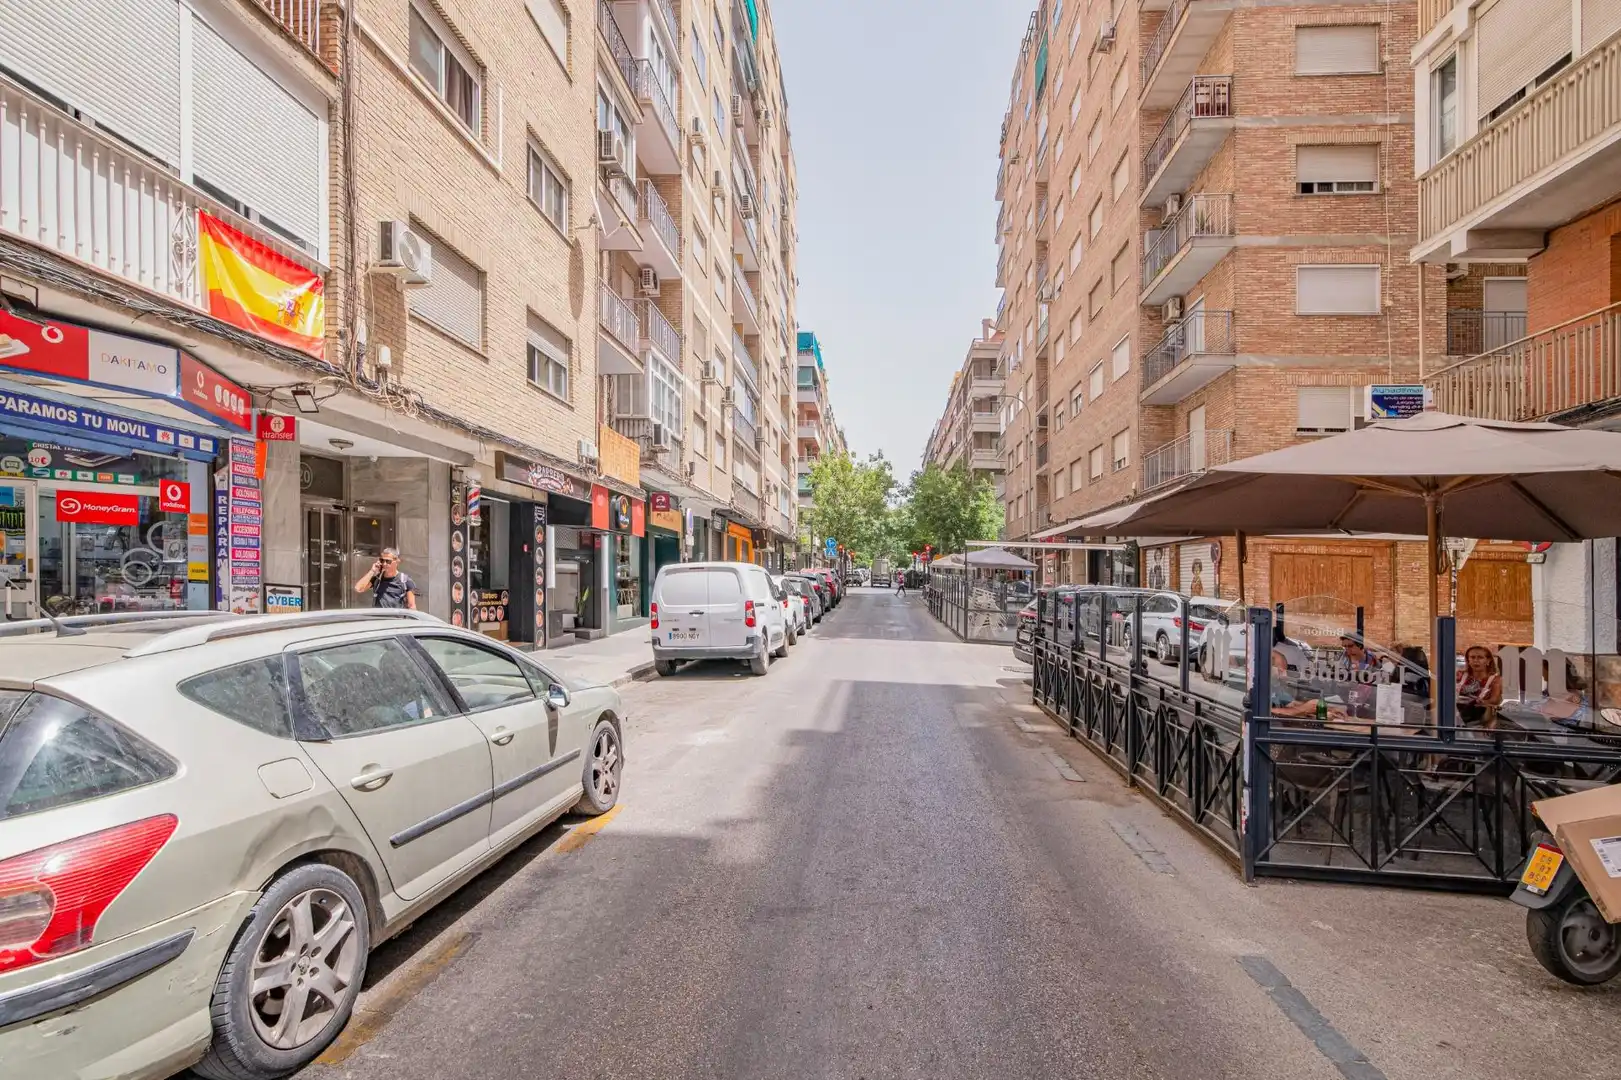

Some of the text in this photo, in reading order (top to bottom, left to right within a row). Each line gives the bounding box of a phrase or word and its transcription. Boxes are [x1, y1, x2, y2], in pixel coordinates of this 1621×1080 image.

[101, 352, 167, 375] DAKITAMO
[82, 412, 103, 428] TU
[107, 418, 150, 438] MOVIL
[83, 503, 136, 514] MoneyGram
[162, 501, 186, 509] vodafone
[267, 595, 303, 607] CYBER
